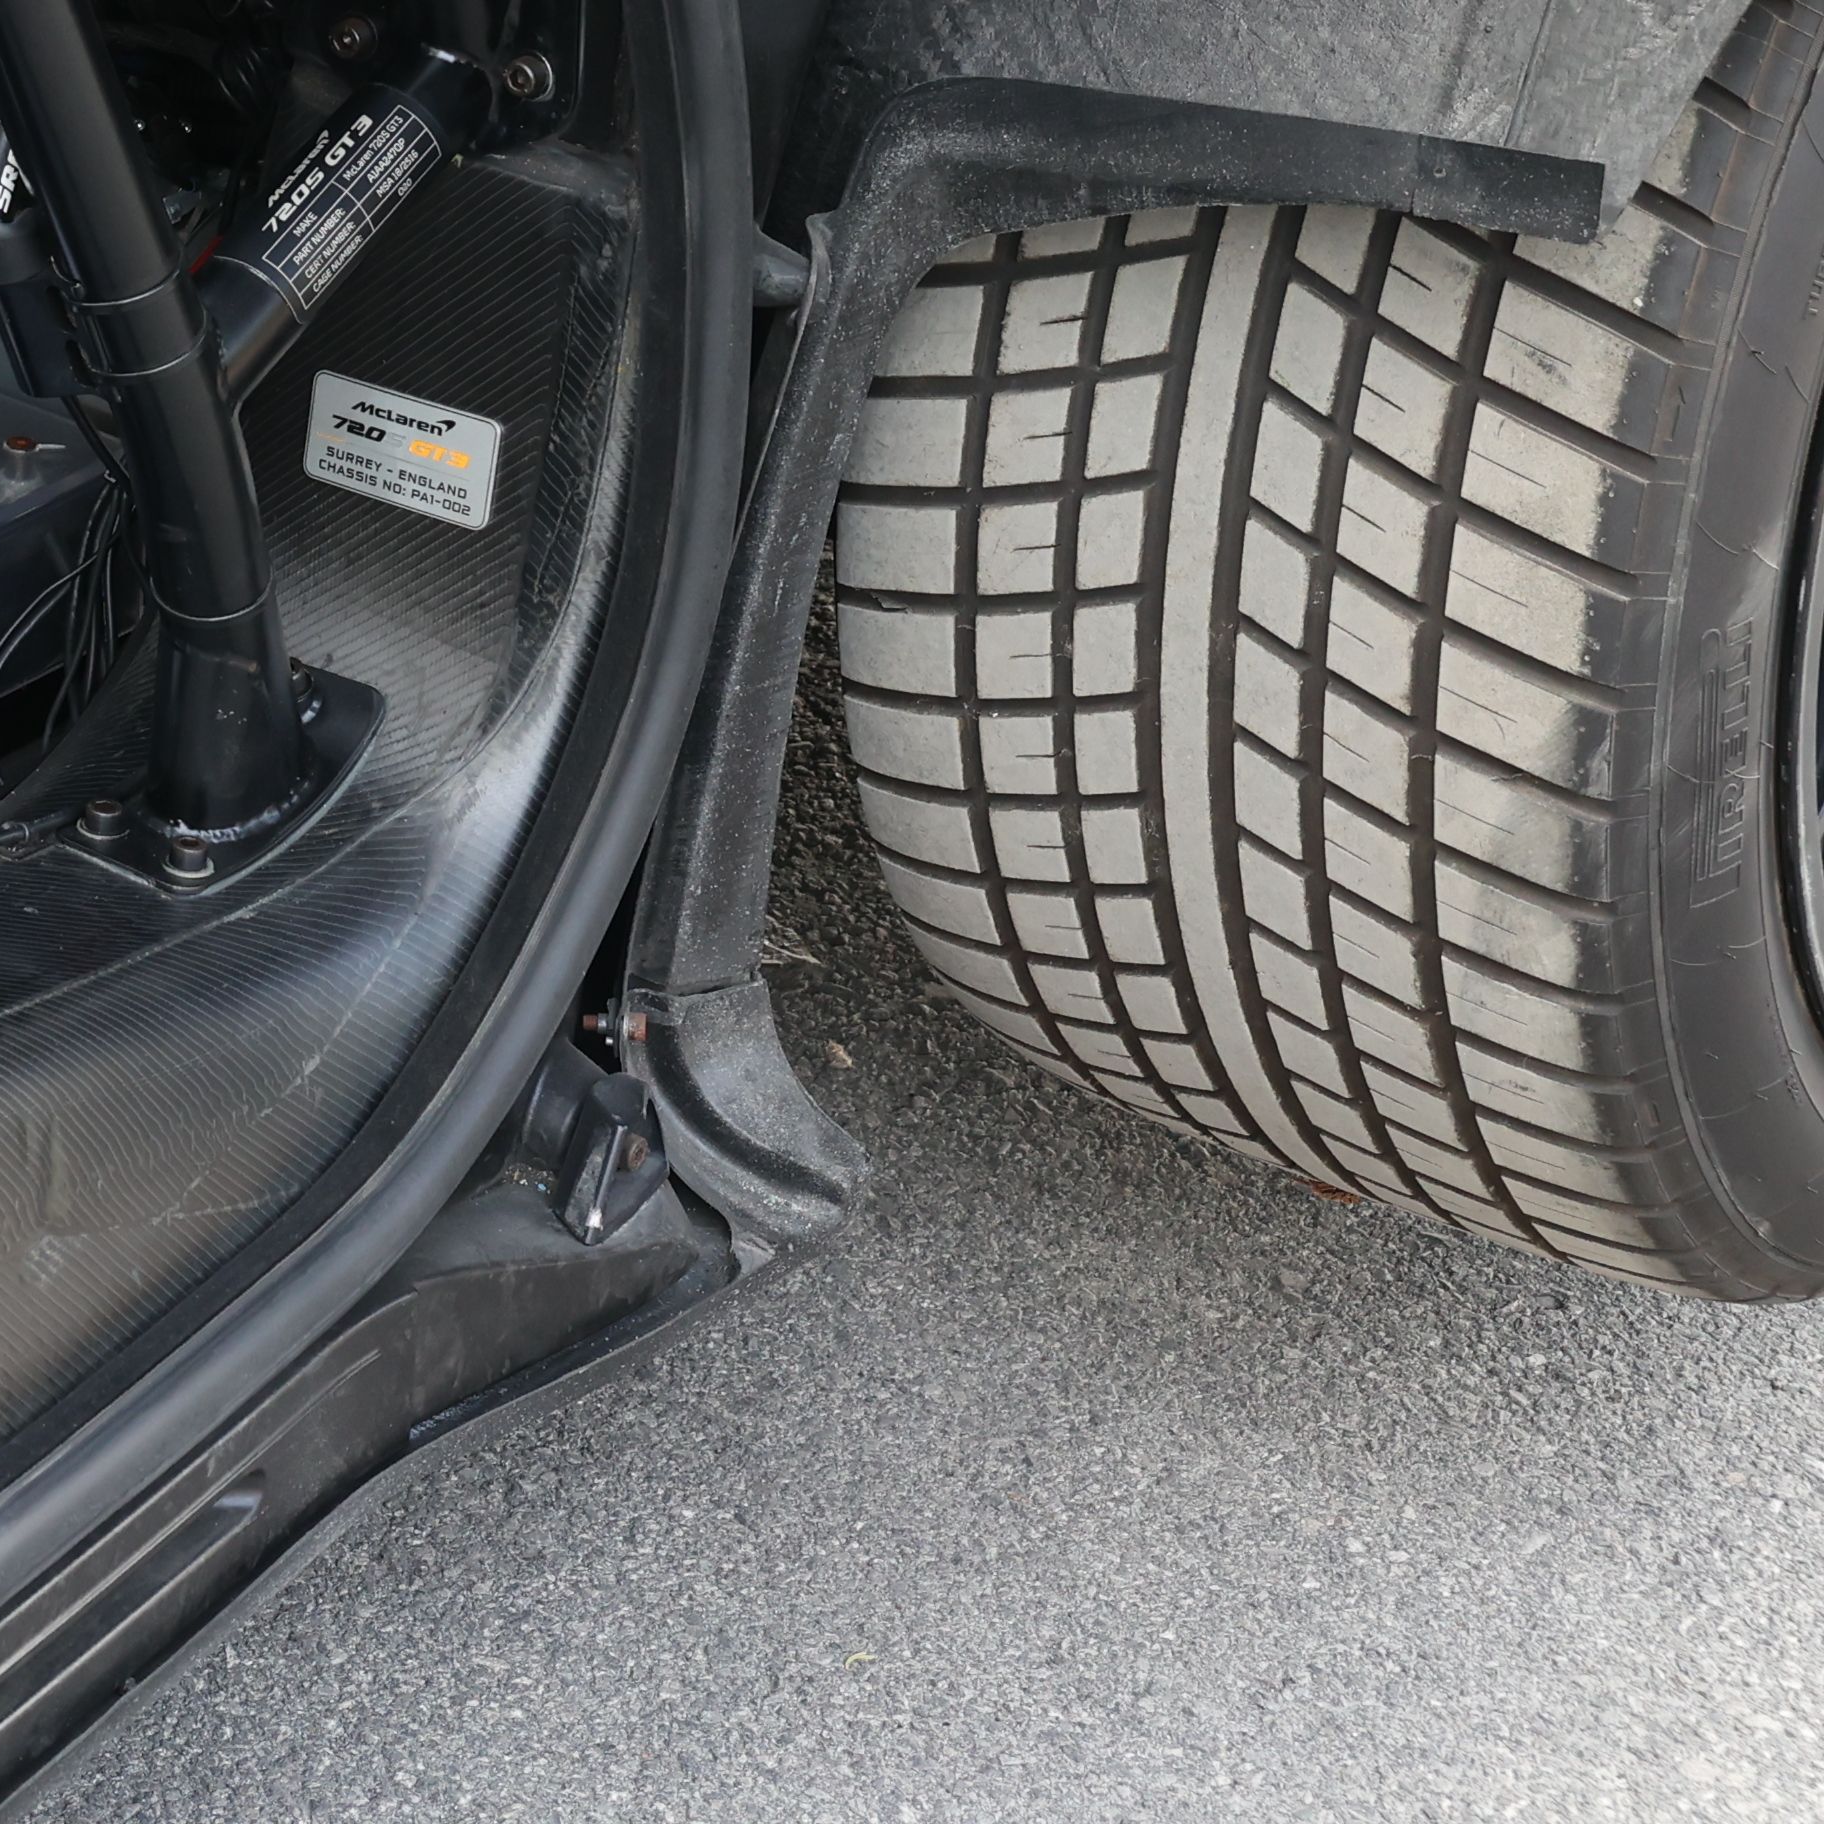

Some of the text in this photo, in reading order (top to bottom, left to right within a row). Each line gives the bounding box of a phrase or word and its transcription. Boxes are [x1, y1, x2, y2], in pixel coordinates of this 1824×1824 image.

[261, 114, 374, 233] 720S GT3
[293, 115, 404, 237] MAKE McLaren 720S GT3
[293, 239, 316, 266] PART
[311, 207, 346, 245] NUMBER:
[304, 256, 325, 279] CERT
[324, 220, 356, 257] NUMBER:
[375, 175, 394, 199] MSA
[312, 266, 334, 293] CAGE
[331, 233, 364, 270] NUMBER:
[351, 401, 444, 437] McLaren
[326, 446, 382, 472] SURREY
[398, 469, 467, 499] ENGLAND
[408, 439, 473, 469] GT3
[319, 459, 471, 516] CHASSIS NO: PA1-002
[1690, 616, 1753, 909] PIRELLI
